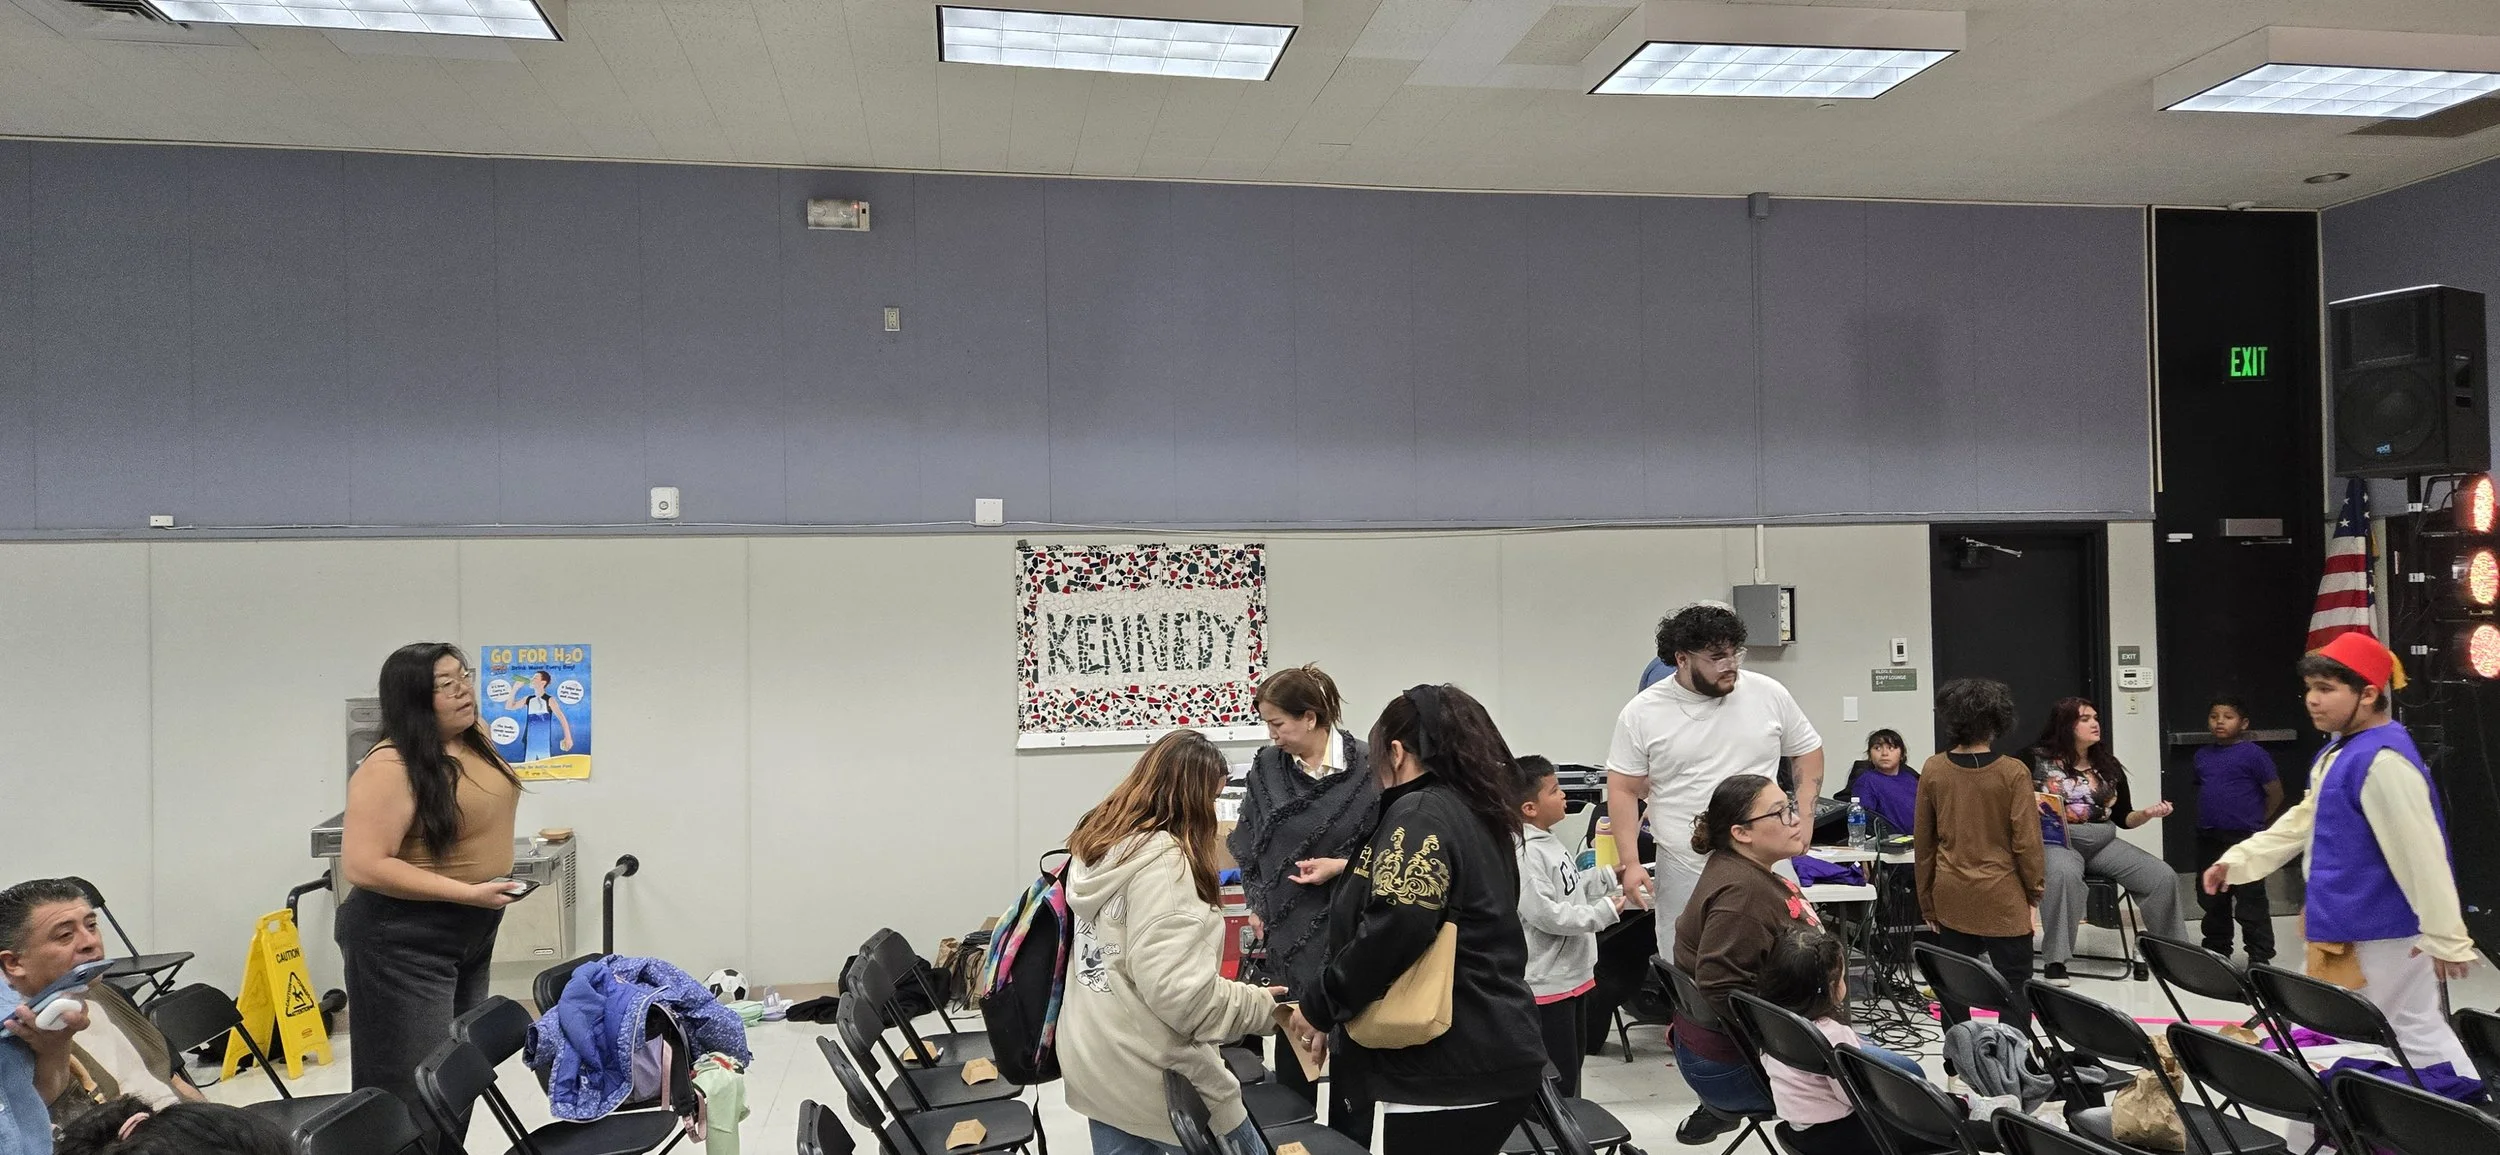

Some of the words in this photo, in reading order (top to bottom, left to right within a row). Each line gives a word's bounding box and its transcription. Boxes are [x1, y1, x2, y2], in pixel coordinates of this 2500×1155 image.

[2231, 346, 2268, 377] EXIT
[1047, 610, 1244, 676] KENNEDY
[491, 649, 512, 663] GO
[518, 648, 547, 663] FOR
[546, 664, 562, 672] Every
[276, 947, 300, 963] CAUTION
